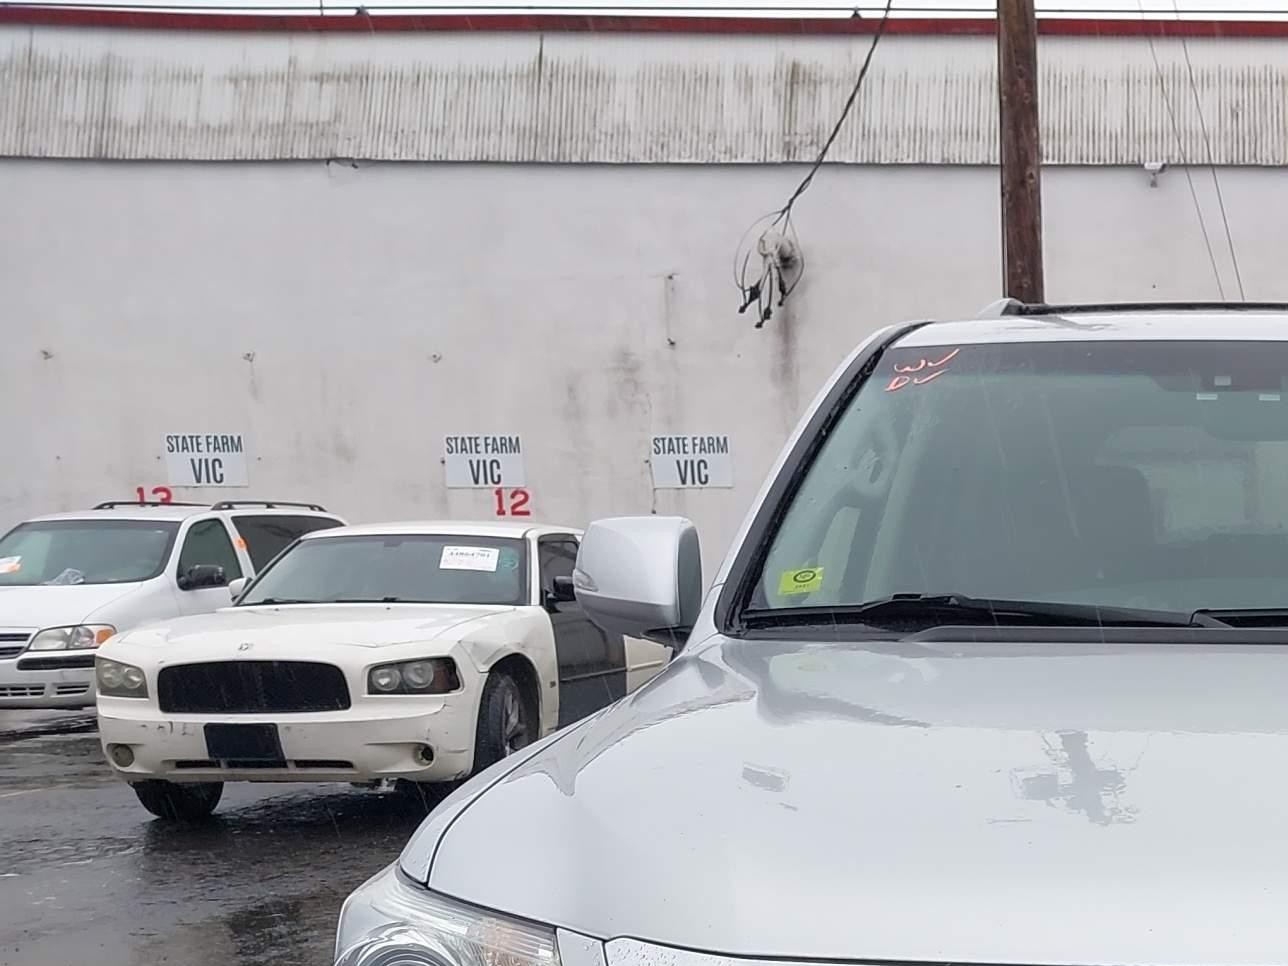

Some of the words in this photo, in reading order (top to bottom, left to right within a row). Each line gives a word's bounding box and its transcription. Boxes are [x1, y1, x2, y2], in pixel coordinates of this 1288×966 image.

[166, 435, 203, 453] STATE
[205, 435, 243, 453] FARM
[446, 436, 481, 454] STATE
[484, 436, 521, 454] FARM
[653, 436, 689, 455] STATE
[691, 436, 729, 454] FARM
[190, 458, 224, 484] VIC
[468, 459, 502, 485] VIC
[676, 459, 709, 485] VIC
[495, 488, 531, 516] 12
